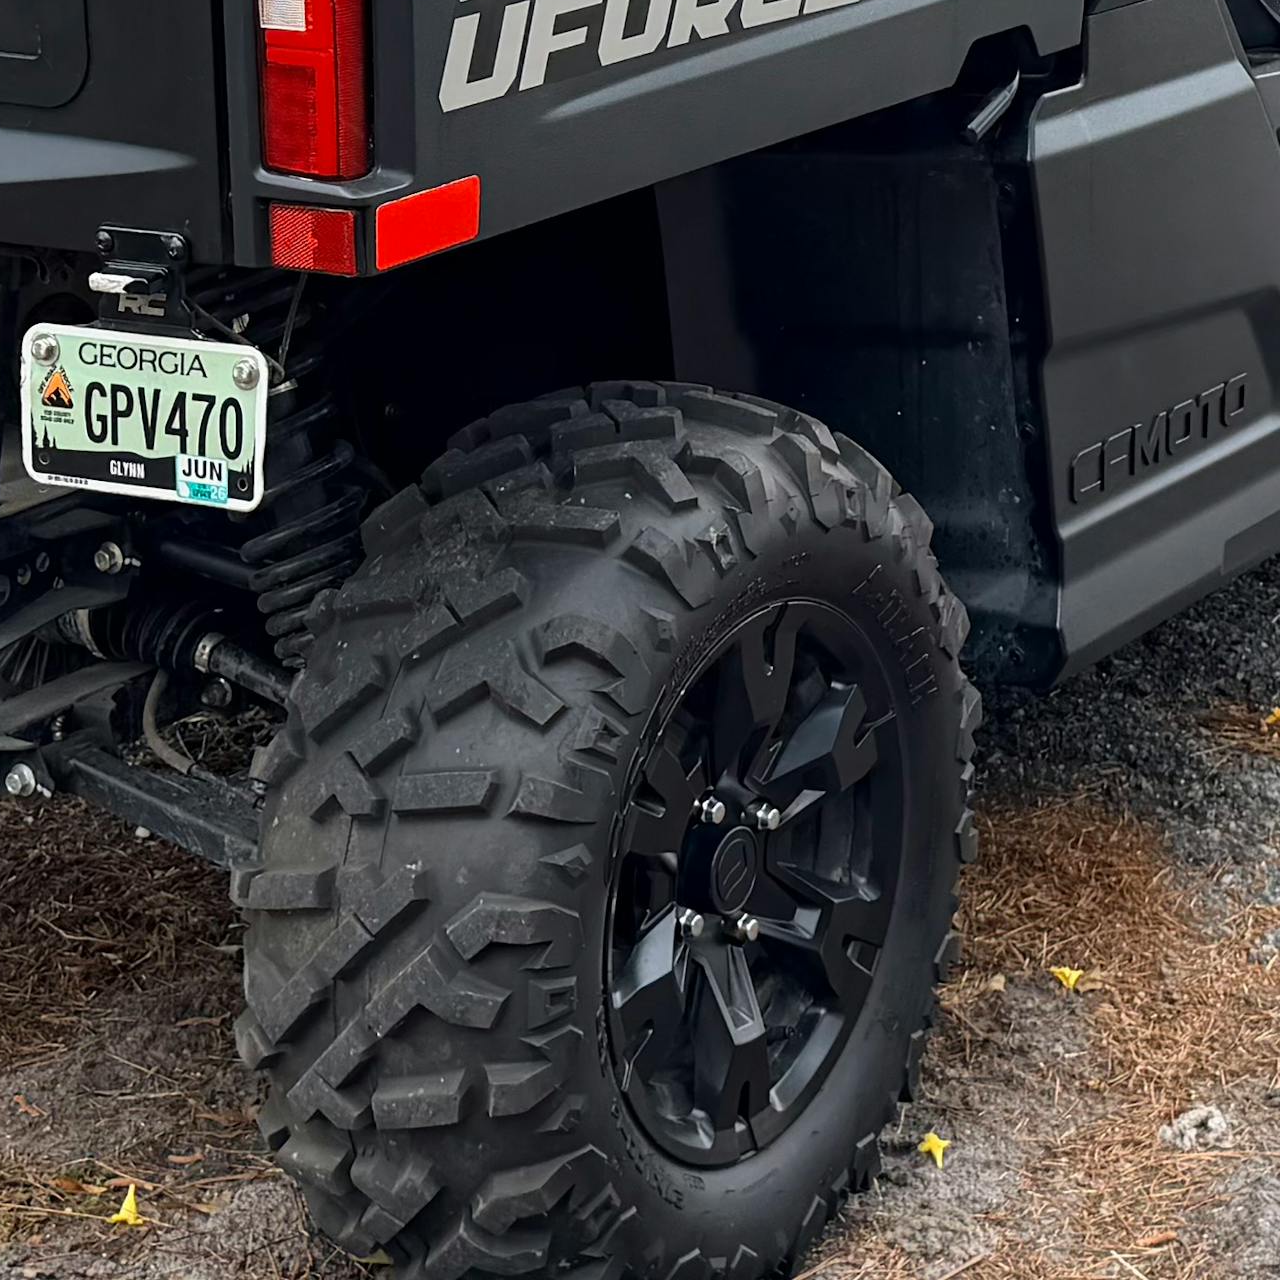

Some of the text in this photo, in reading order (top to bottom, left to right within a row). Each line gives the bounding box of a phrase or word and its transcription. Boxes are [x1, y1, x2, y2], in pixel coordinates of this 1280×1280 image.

[118, 293, 167, 317] RC
[78, 342, 208, 379] GEORGIA
[85, 381, 244, 460] GPV470
[1068, 372, 1248, 504] CFMOTO
[110, 459, 145, 479] GLYNN
[182, 458, 222, 481] JUN
